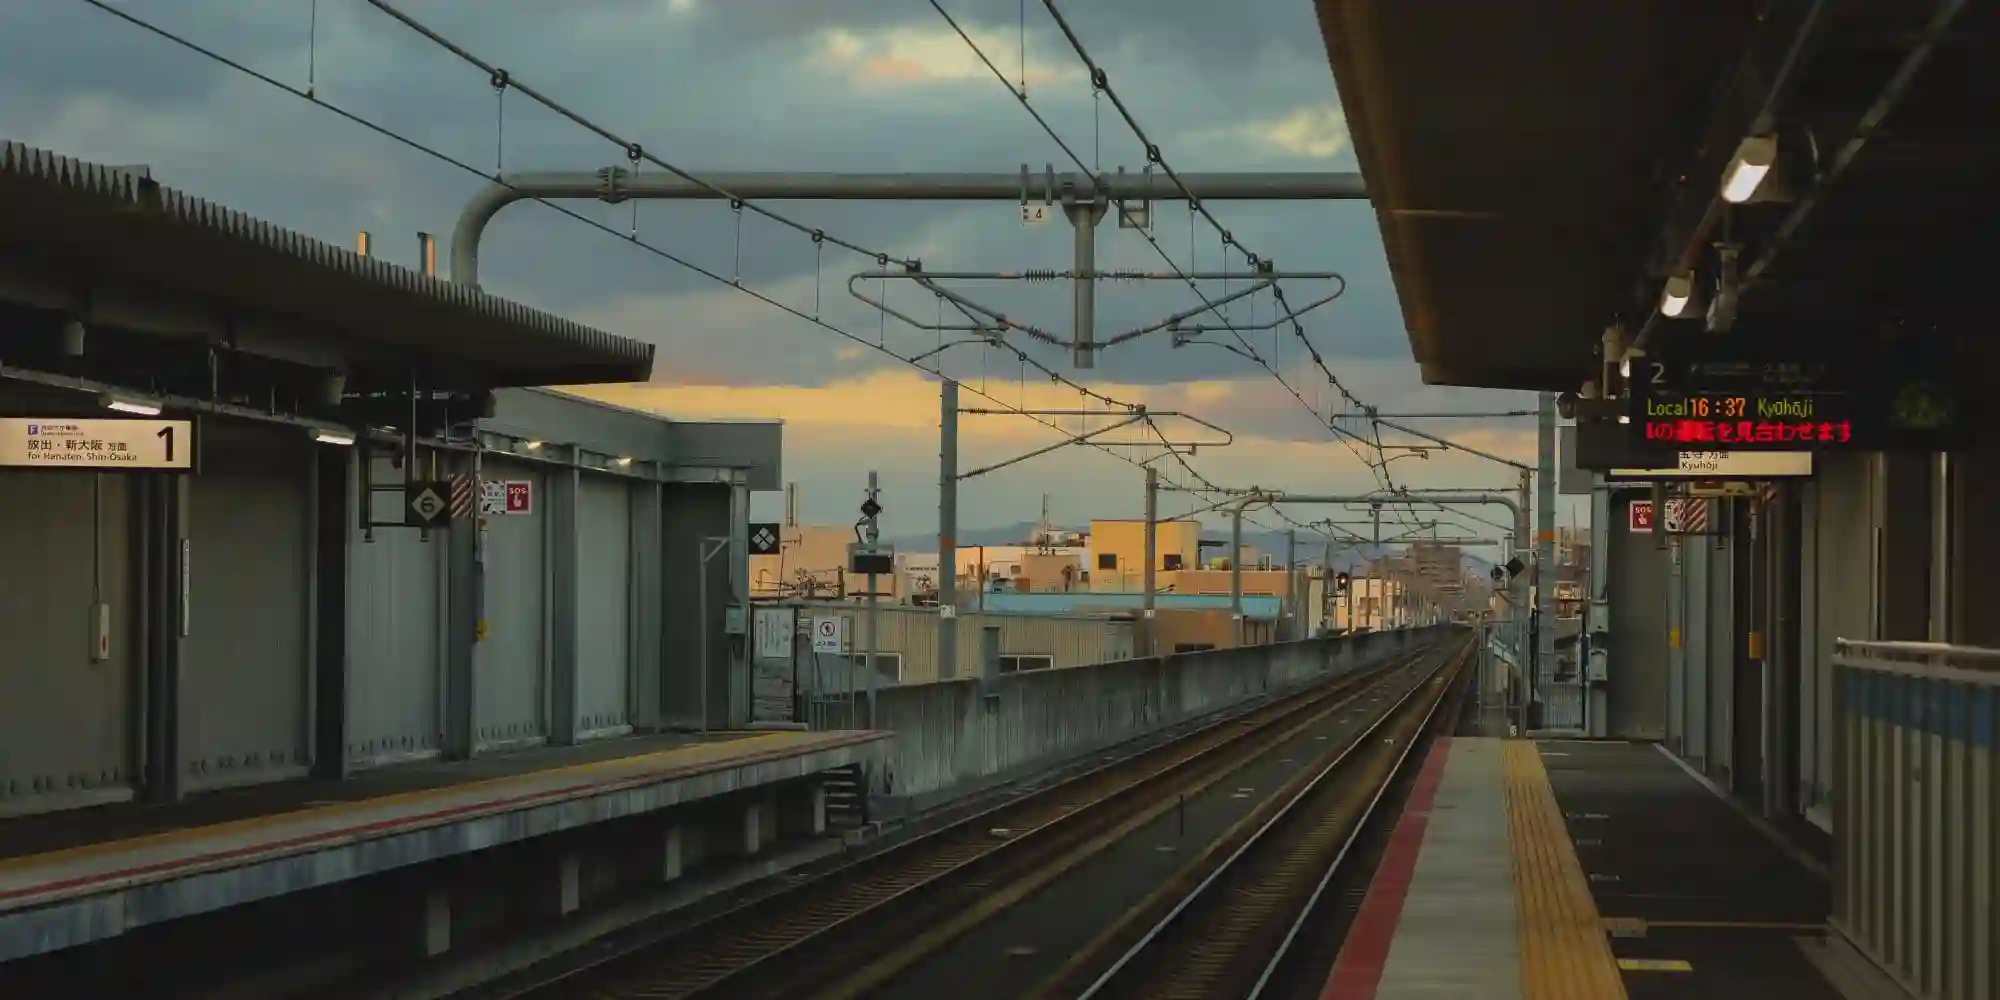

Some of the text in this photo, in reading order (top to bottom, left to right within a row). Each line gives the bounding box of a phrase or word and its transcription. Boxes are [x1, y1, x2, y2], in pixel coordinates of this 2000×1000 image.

[1651, 362, 1666, 383] 2
[1647, 398, 1687, 416] Local
[1690, 398, 1746, 417] 16:37
[27, 439, 103, 452] 放出・新大阪
[157, 426, 174, 462] 1
[27, 452, 40, 461] for
[508, 487, 527, 495] SOS
[420, 496, 435, 514] 6
